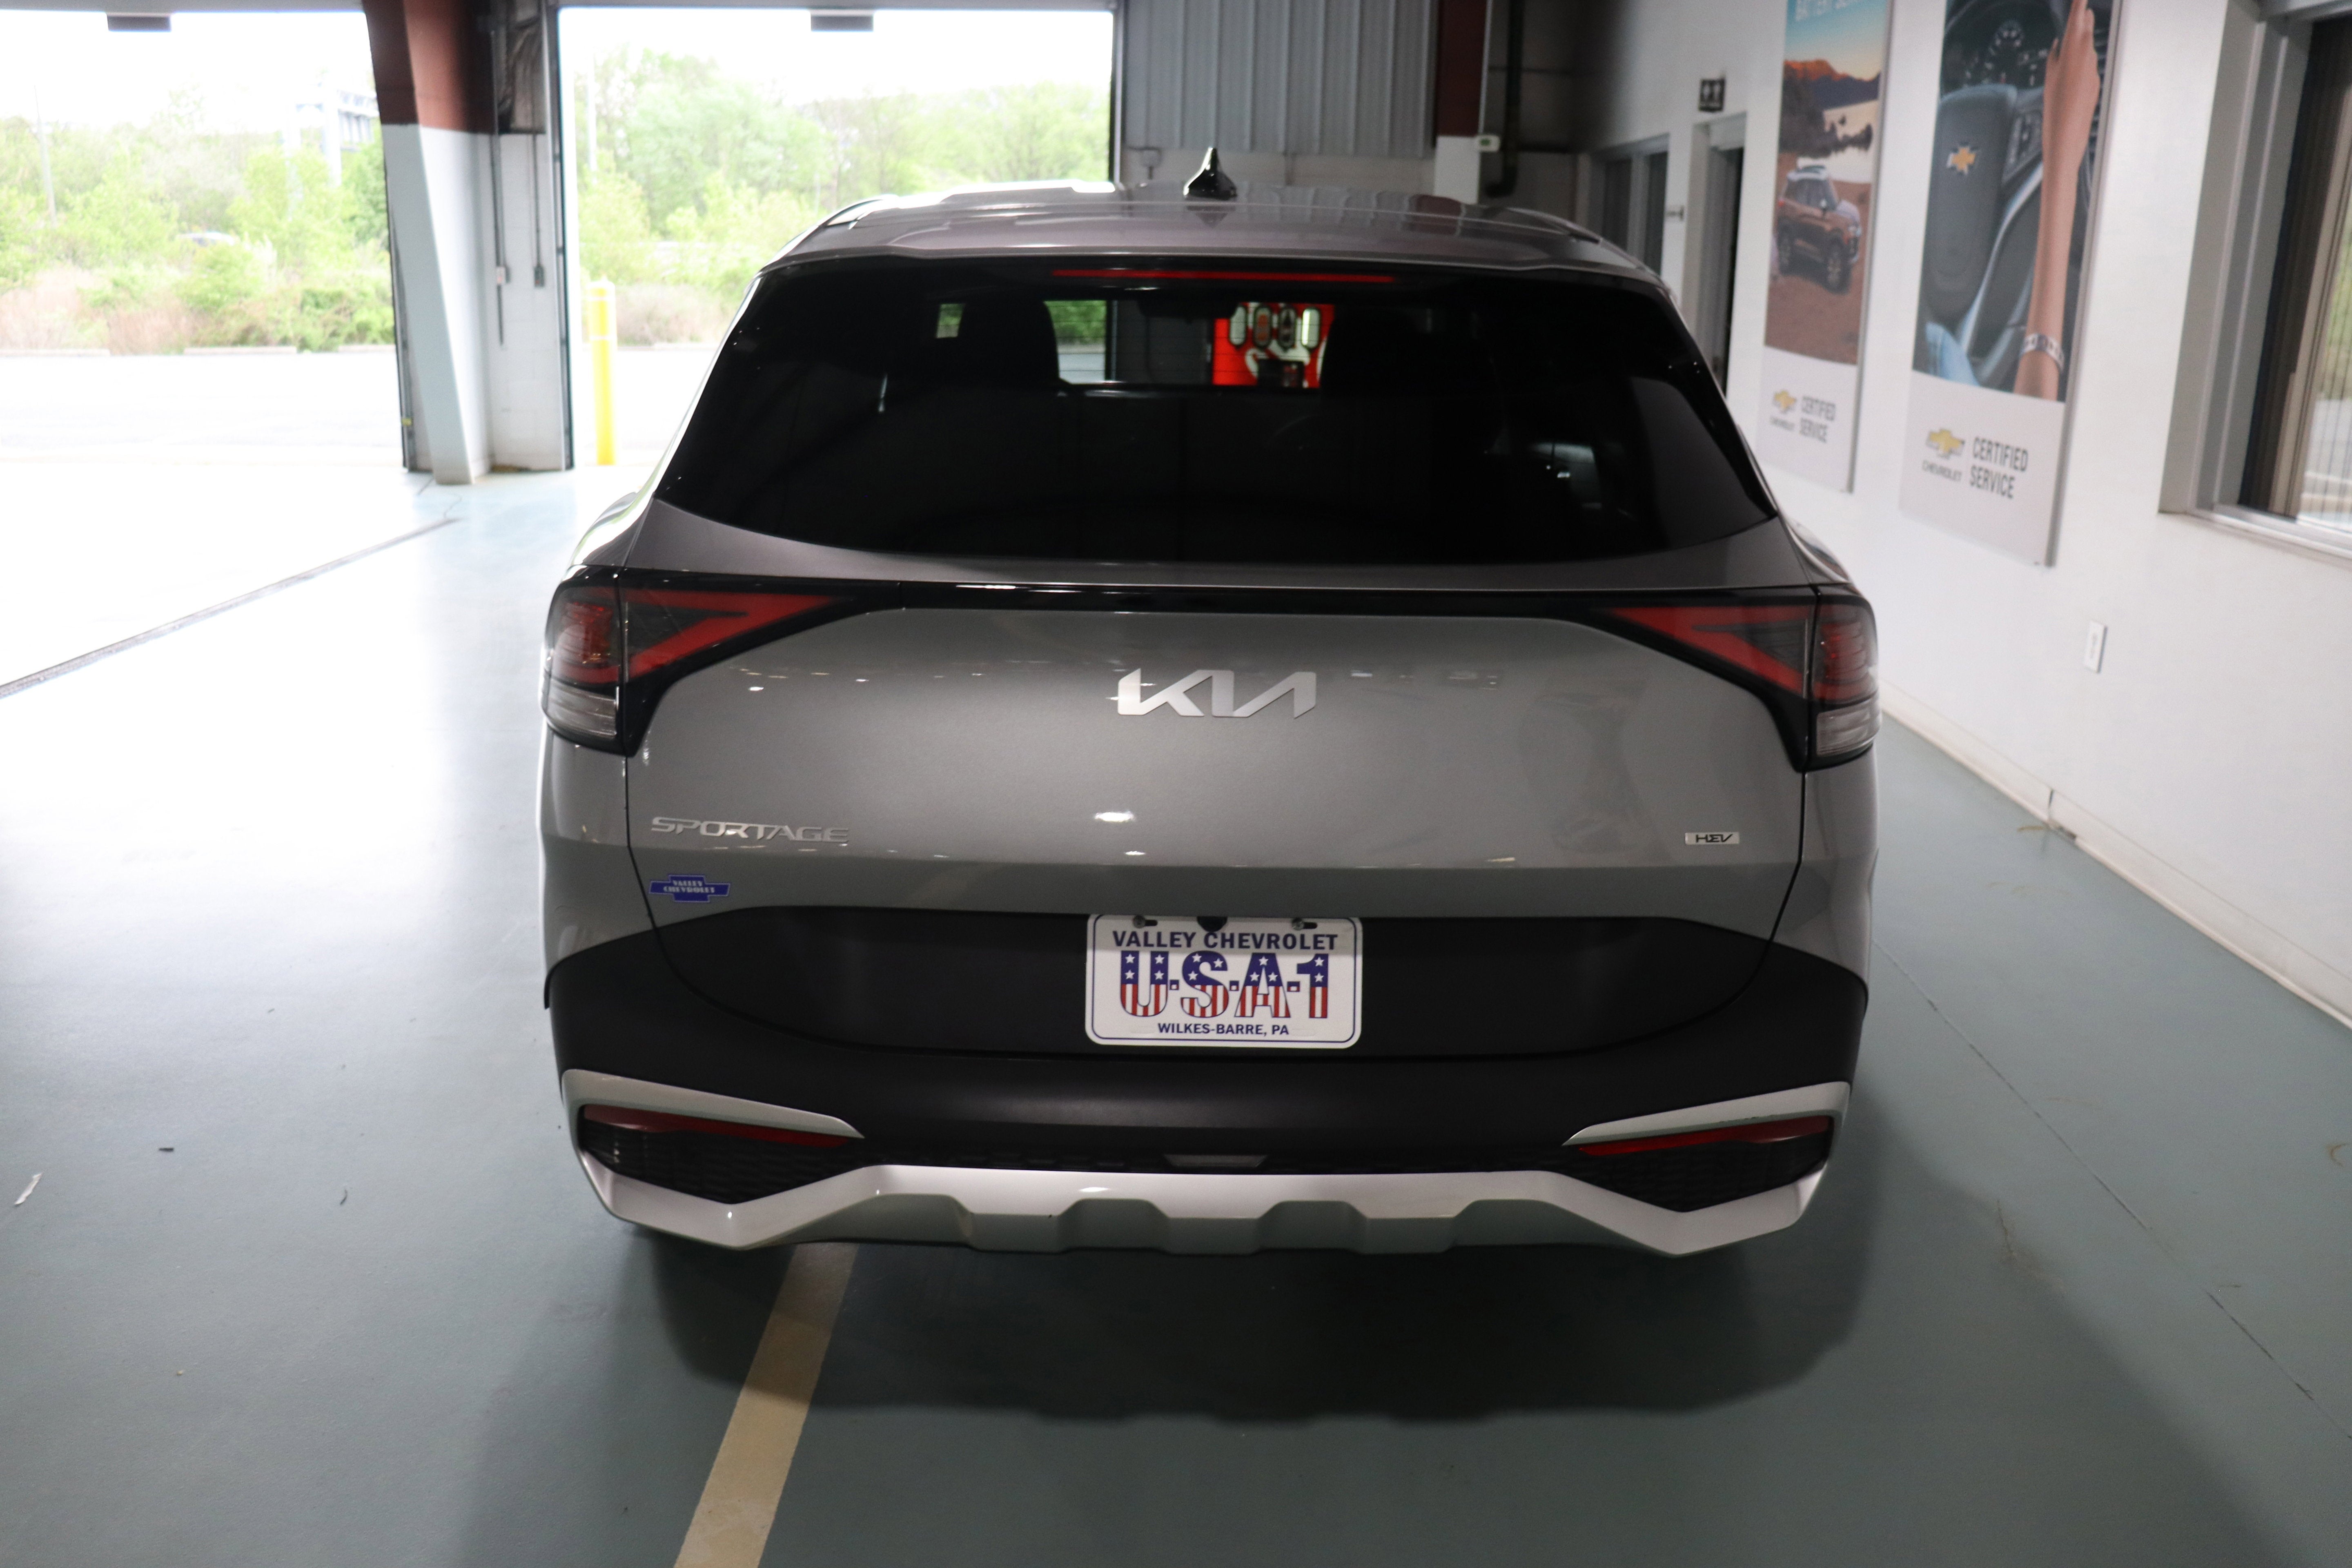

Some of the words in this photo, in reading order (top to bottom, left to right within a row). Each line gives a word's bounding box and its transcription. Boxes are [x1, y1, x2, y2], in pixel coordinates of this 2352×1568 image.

[1972, 436, 2028, 472] CERTIFIED
[1969, 464, 2016, 499] SERVICE
[1118, 668, 1316, 719] KIA
[651, 816, 849, 842] SPORTAGE
[1696, 834, 1733, 843] HEV
[1112, 930, 1196, 948] VALLEY
[1203, 931, 1338, 950] CHEVROLET
[1158, 1022, 1267, 1037] WILKES-BARRE,
[1271, 1025, 1289, 1035] PA
